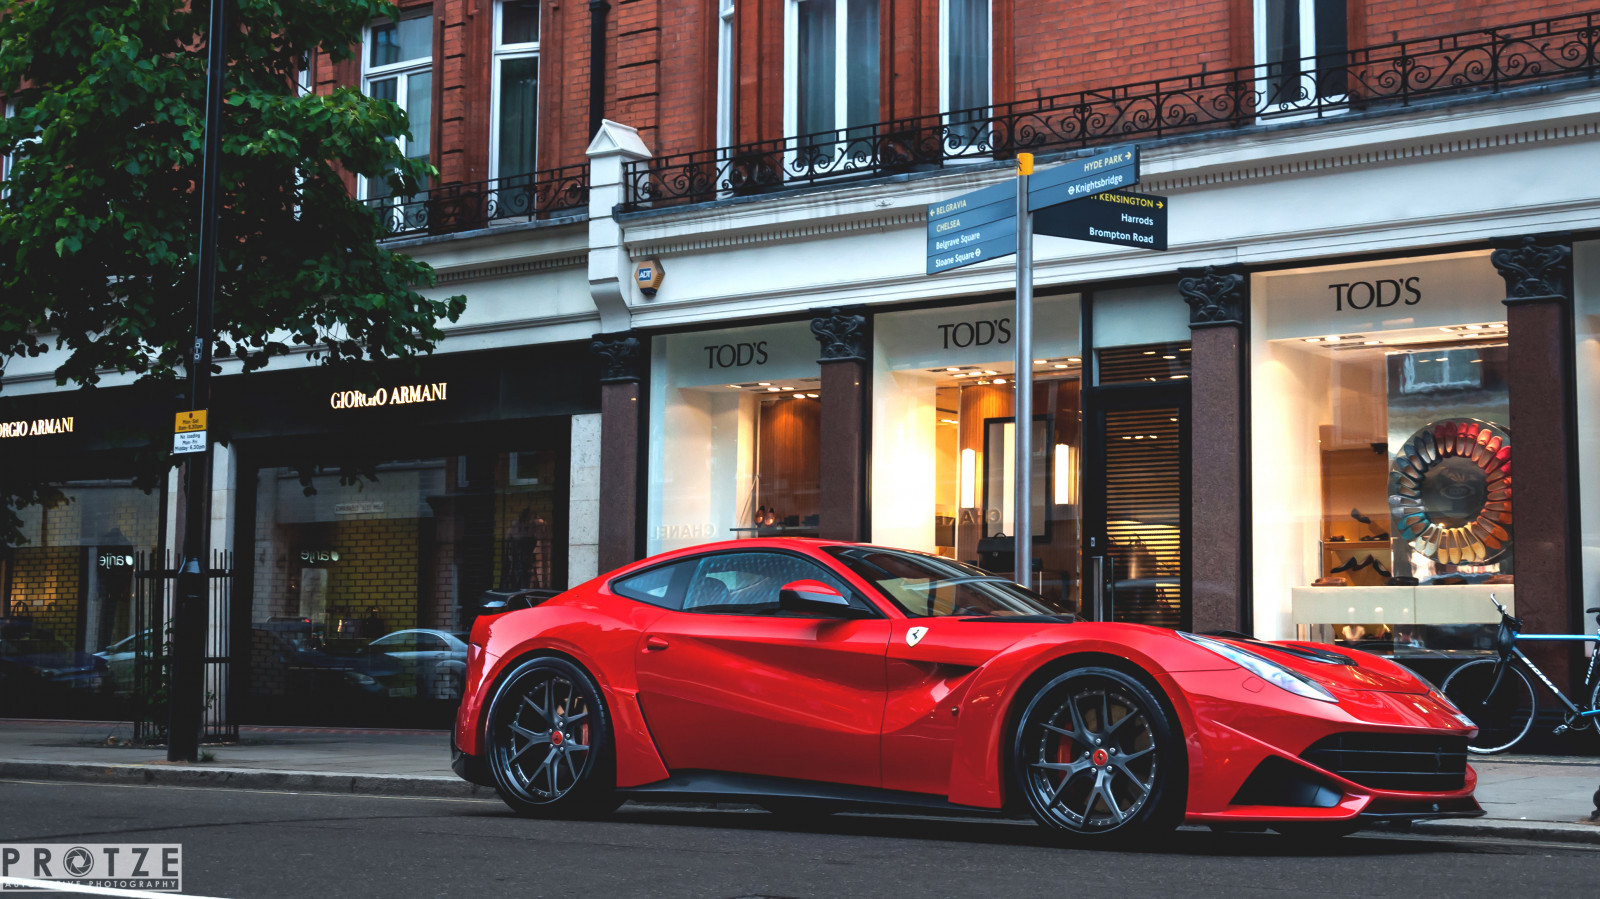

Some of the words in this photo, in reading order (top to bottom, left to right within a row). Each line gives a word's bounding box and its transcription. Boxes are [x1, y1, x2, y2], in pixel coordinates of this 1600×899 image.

[1084, 160, 1103, 172] HYDE
[1104, 154, 1123, 166] PARK
[1075, 174, 1123, 193] Knightsbridge
[936, 200, 967, 215] BELGRAVIA
[1099, 193, 1154, 208] KENSINGTON
[936, 219, 961, 232] CHELSEA
[1121, 213, 1154, 226] Harrods
[936, 238, 960, 250] Belgrave
[960, 232, 981, 244] Square
[1089, 226, 1131, 240] Brompton
[1132, 232, 1154, 244] Road
[935, 257, 954, 268] Sloane
[955, 251, 975, 263] Square
[639, 270, 651, 279] ADT
[1328, 276, 1422, 311] TOD'S
[938, 318, 1011, 349] TOD'S
[704, 341, 768, 369] TOD'S
[389, 382, 448, 405] ARMANI
[29, 416, 75, 436] ARMANI
